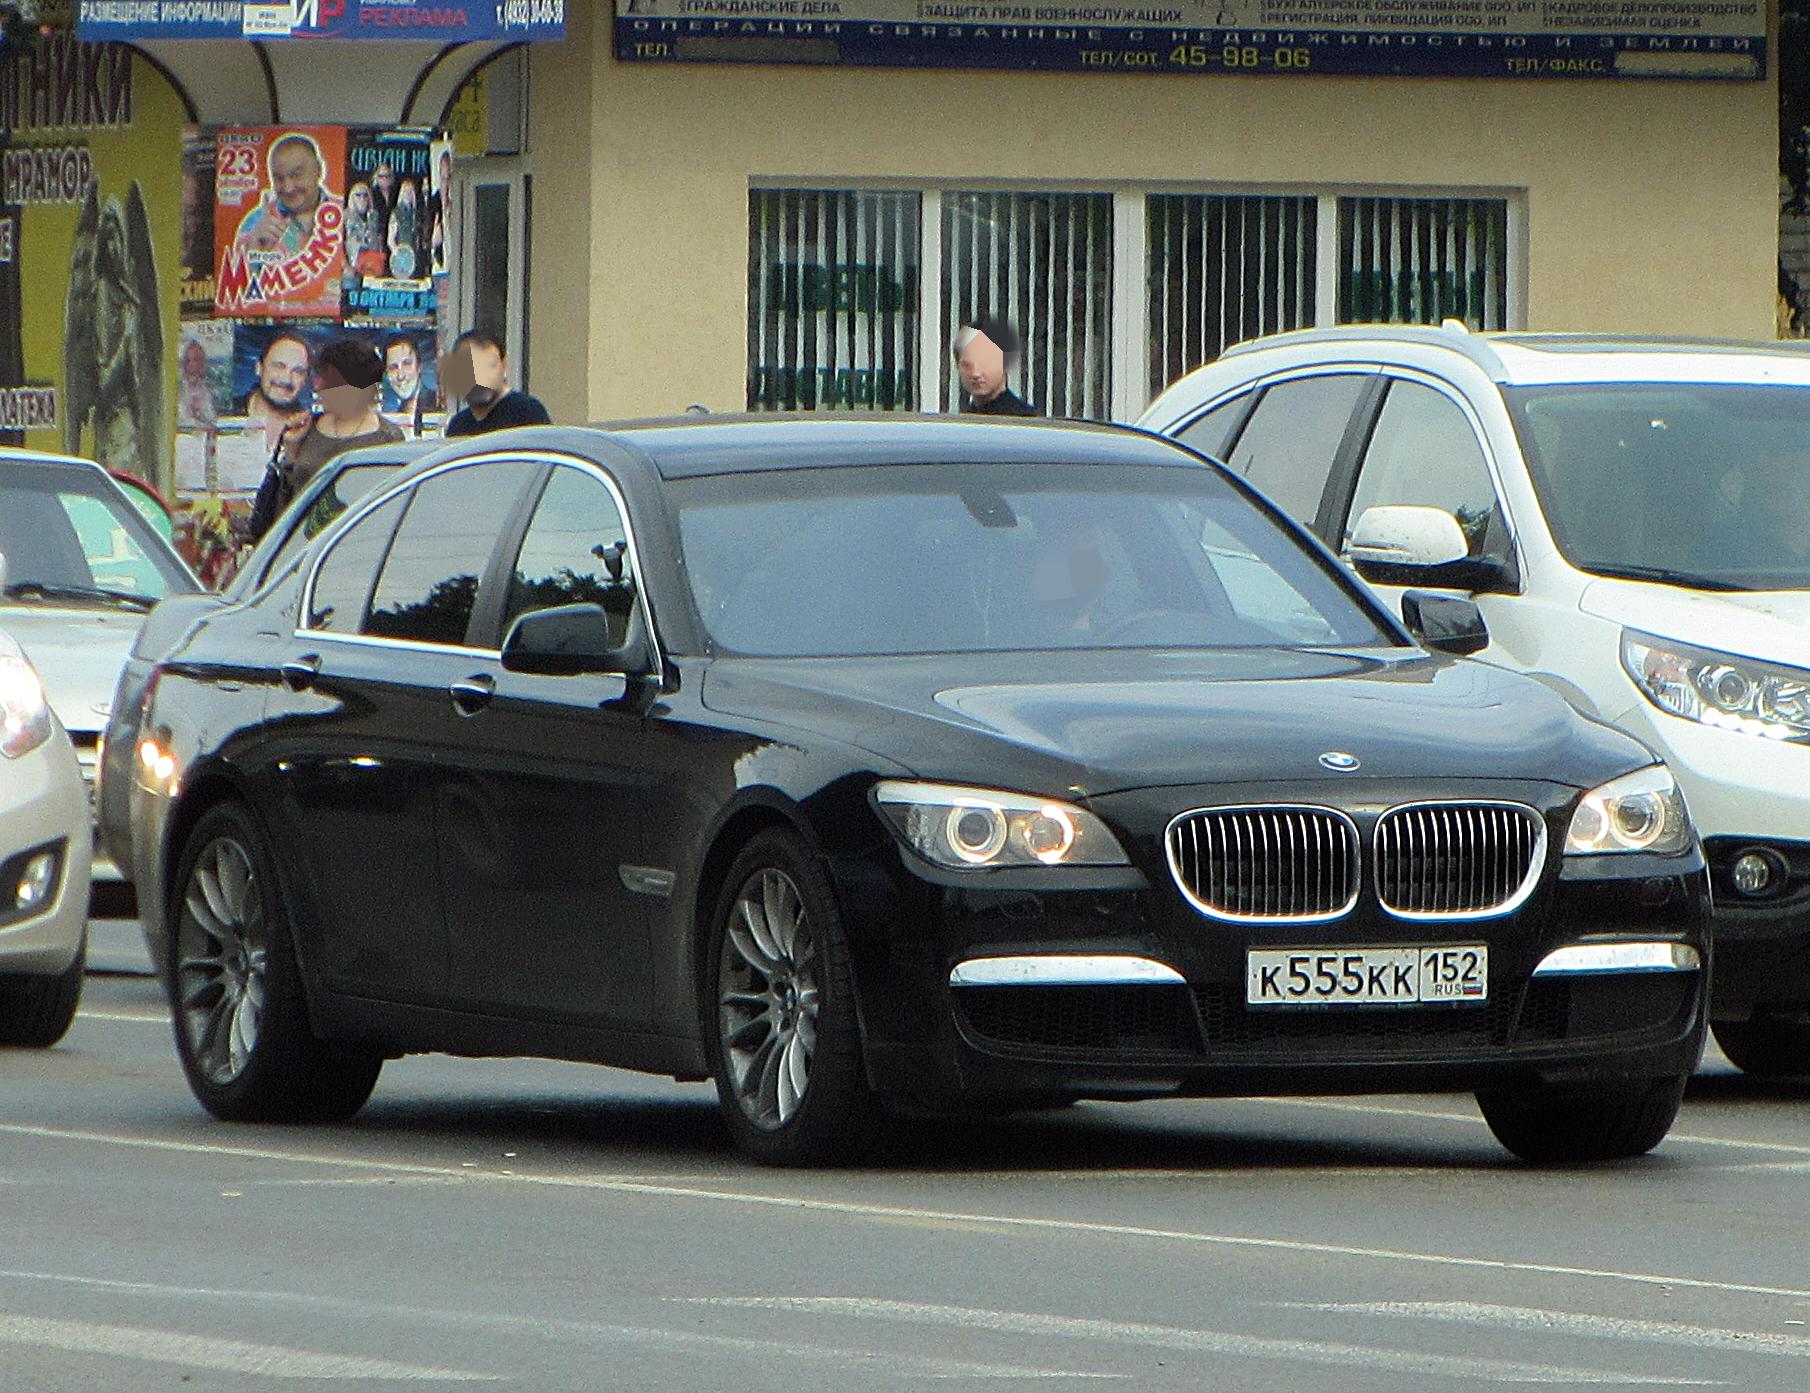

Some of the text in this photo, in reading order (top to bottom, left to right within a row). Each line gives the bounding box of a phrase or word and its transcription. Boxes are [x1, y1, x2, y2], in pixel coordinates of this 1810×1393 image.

[80, 1, 159, 24] РАЗМЕЩЕНИЕ
[161, 1, 241, 24] ИНФОРМАЦИИ
[359, 7, 468, 27] РЕКЛАМА
[686, 0, 841, 14] ГРАЖДАНСКИЕ ДЕЛА
[924, 4, 1183, 22] ЗАЩИТА ПРАВ ВОЕННОСЛУЖАЩИХ
[634, 20, 840, 33] ОПЕРАЦИИ
[869, 24, 1102, 40] СВЯЗАННЫЕ
[1172, 31, 1526, 47] НЕДВИЖИМОСТЬЮ
[1556, 37, 1571, 48] И
[1169, 45, 1311, 68] 45-98-06
[219, 147, 257, 176] 23
[4, 147, 91, 204] МРАМОР
[1424, 952, 1478, 982] 152
[1434, 983, 1462, 996] RUS
